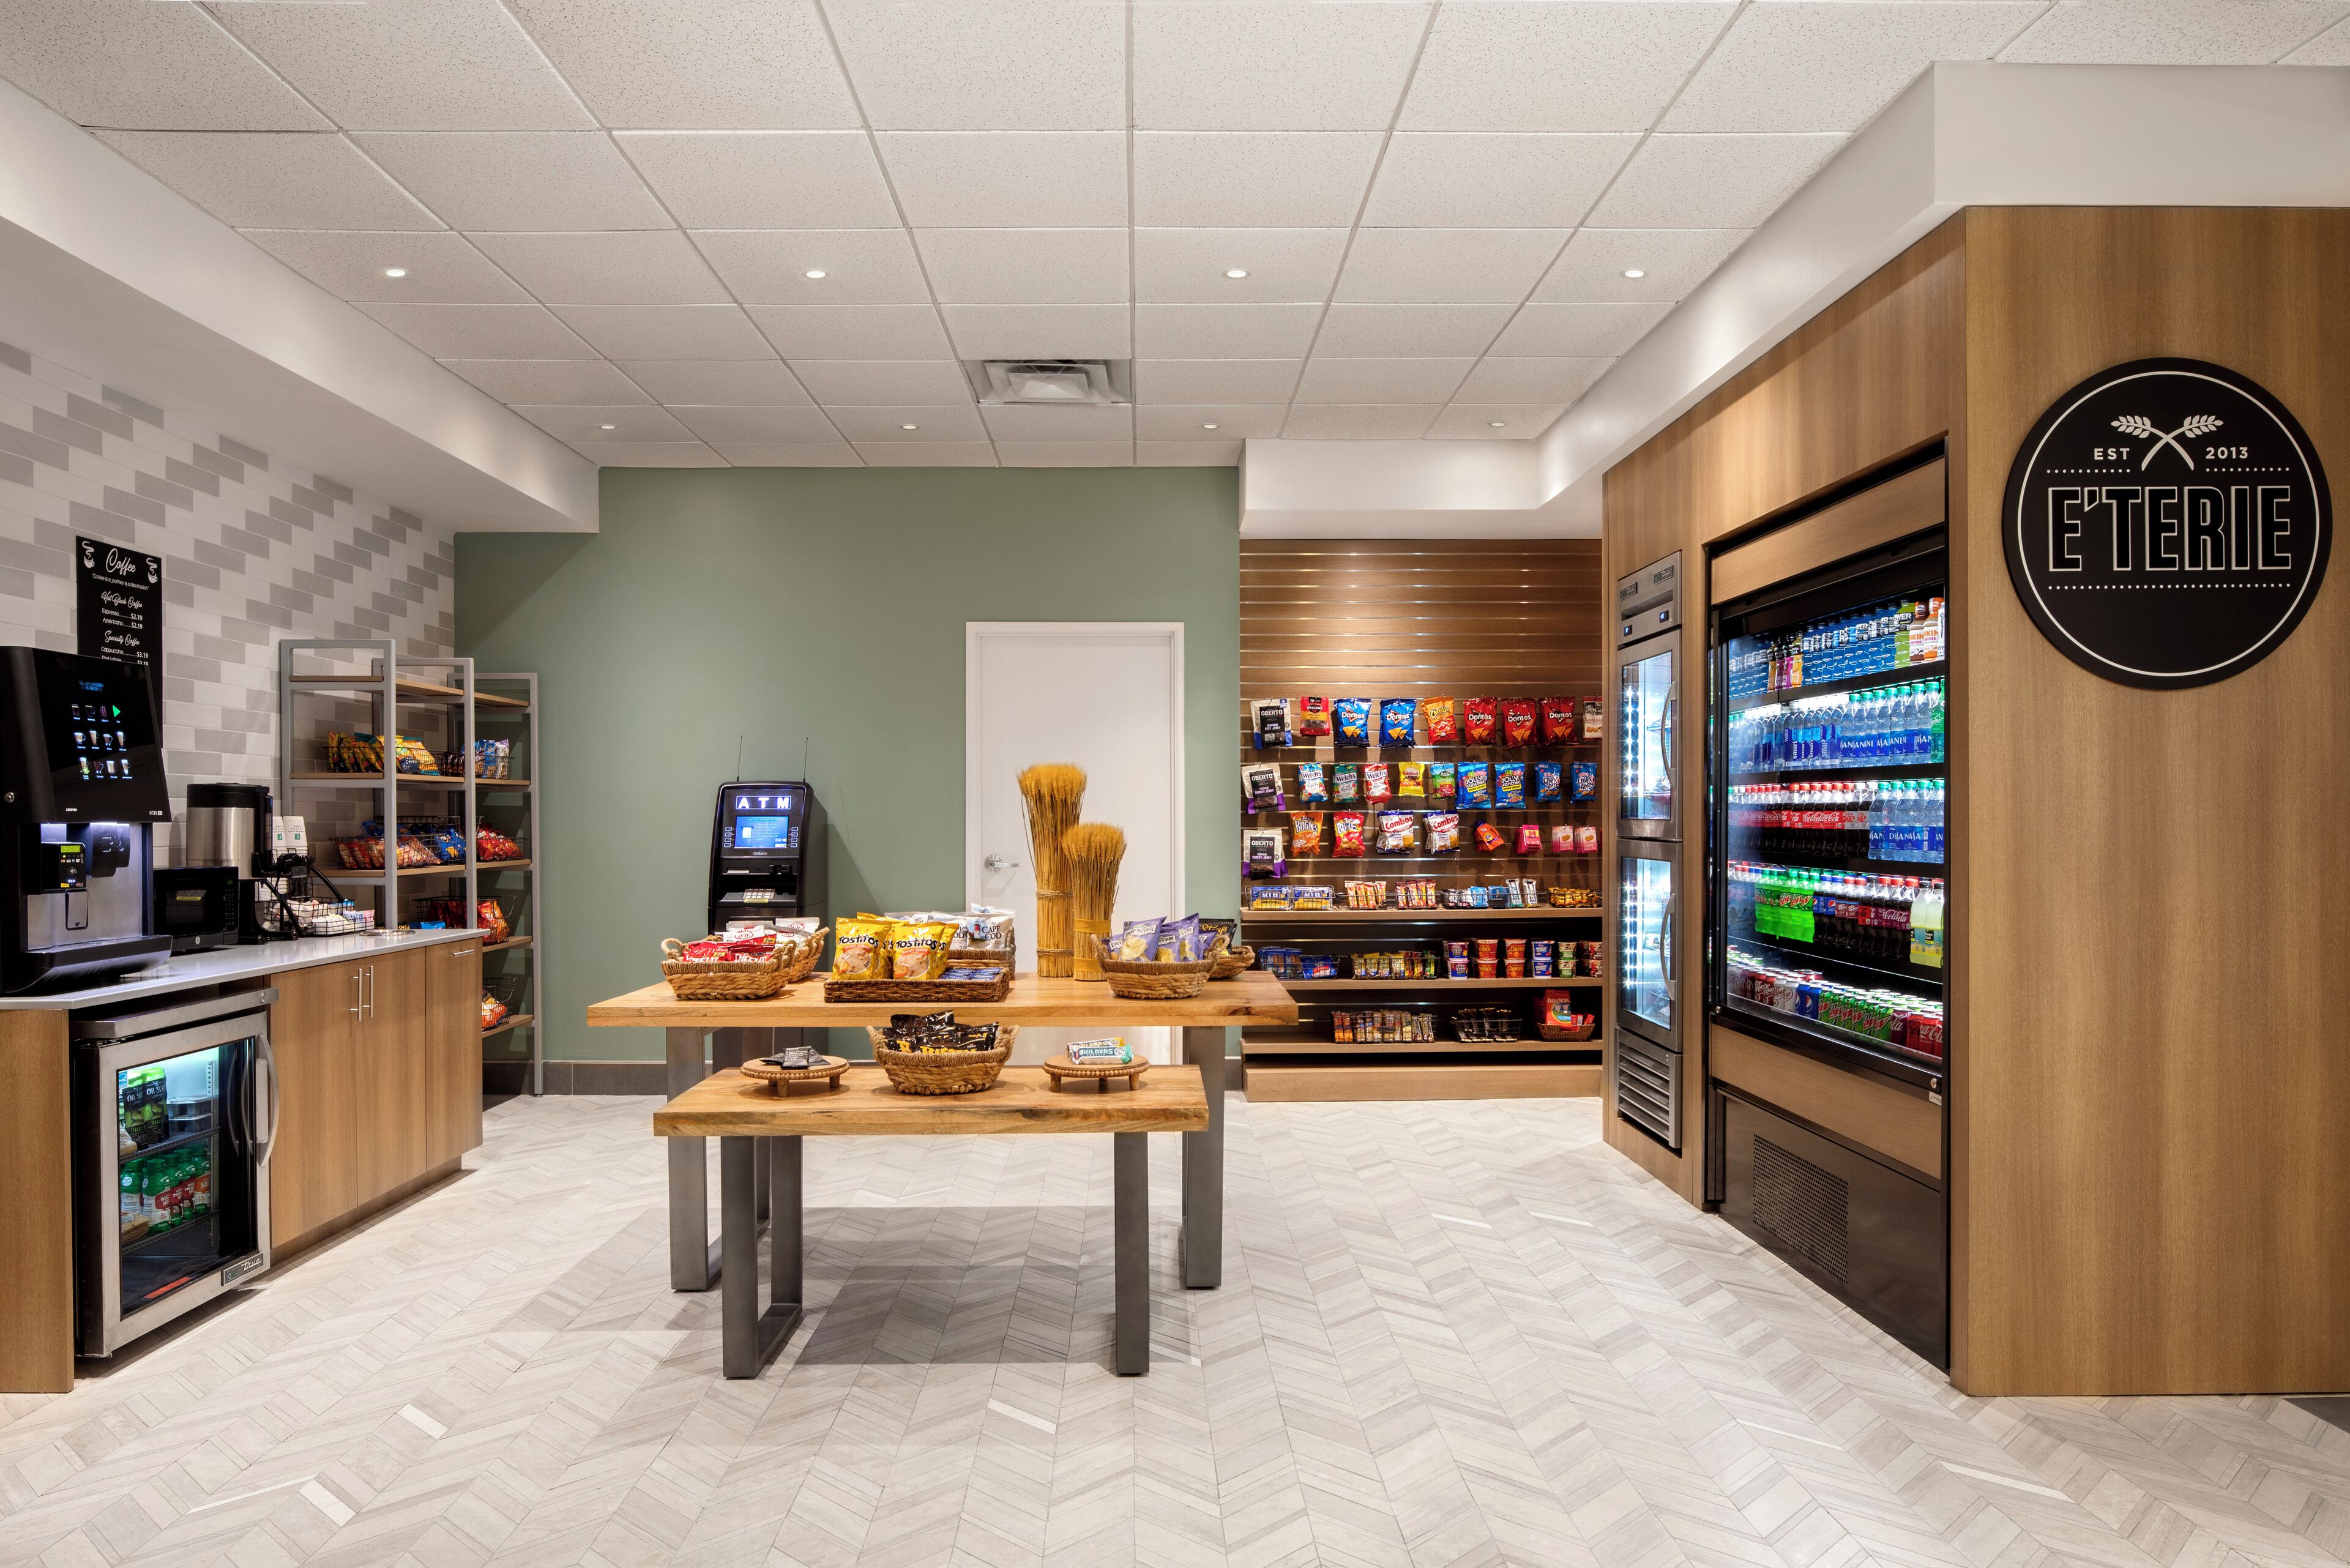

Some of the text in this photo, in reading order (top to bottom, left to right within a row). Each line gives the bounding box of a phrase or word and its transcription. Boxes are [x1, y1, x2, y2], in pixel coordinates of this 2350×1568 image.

[2094, 447, 2248, 460] EST 2013
[2048, 485, 2291, 571] E'TERIE
[106, 548, 136, 575] Coffee
[101, 591, 143, 609] Hot Black Coffee
[105, 630, 140, 646] Specialty Coffee
[1386, 712, 1409, 720] Doritos
[1430, 706, 1449, 720] Cheetos
[1507, 714, 1531, 723] Doritos
[1367, 771, 1387, 779] Welch's
[1466, 775, 1482, 785] JOLLY
[1501, 775, 1519, 784] JOLLY
[1467, 780, 1485, 788] rancher
[737, 797, 789, 808] ATM
[1294, 820, 1318, 833] BUGLES
[1386, 816, 1413, 830] Combos
[1433, 815, 1458, 829] Combos
[982, 925, 1001, 934] CAPE
[838, 935, 879, 949] TOSTITOS
[985, 932, 1002, 941] COD
[896, 938, 938, 950] TOSTITOS
